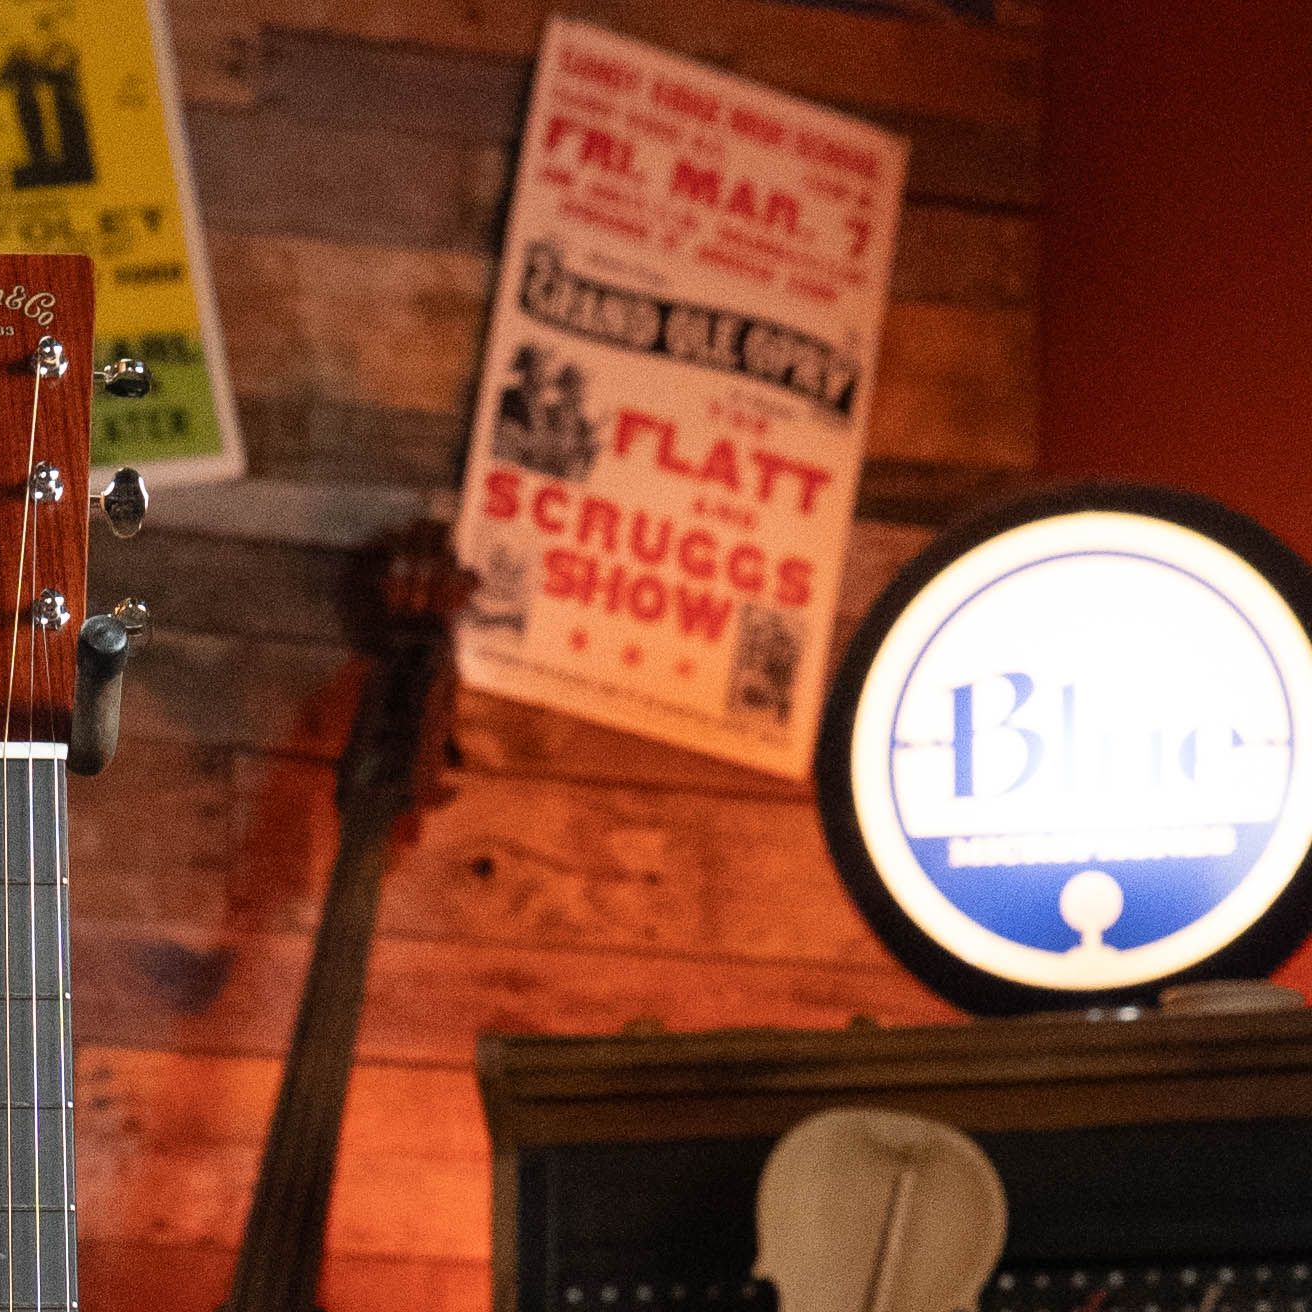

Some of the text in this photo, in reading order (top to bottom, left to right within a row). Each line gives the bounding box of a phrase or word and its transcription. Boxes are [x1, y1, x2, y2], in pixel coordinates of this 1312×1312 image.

[614, 406, 834, 518] FLATT
[483, 467, 816, 608] SCRUGGS
[542, 546, 735, 645] SHOW
[950, 670, 1245, 799] Blue
